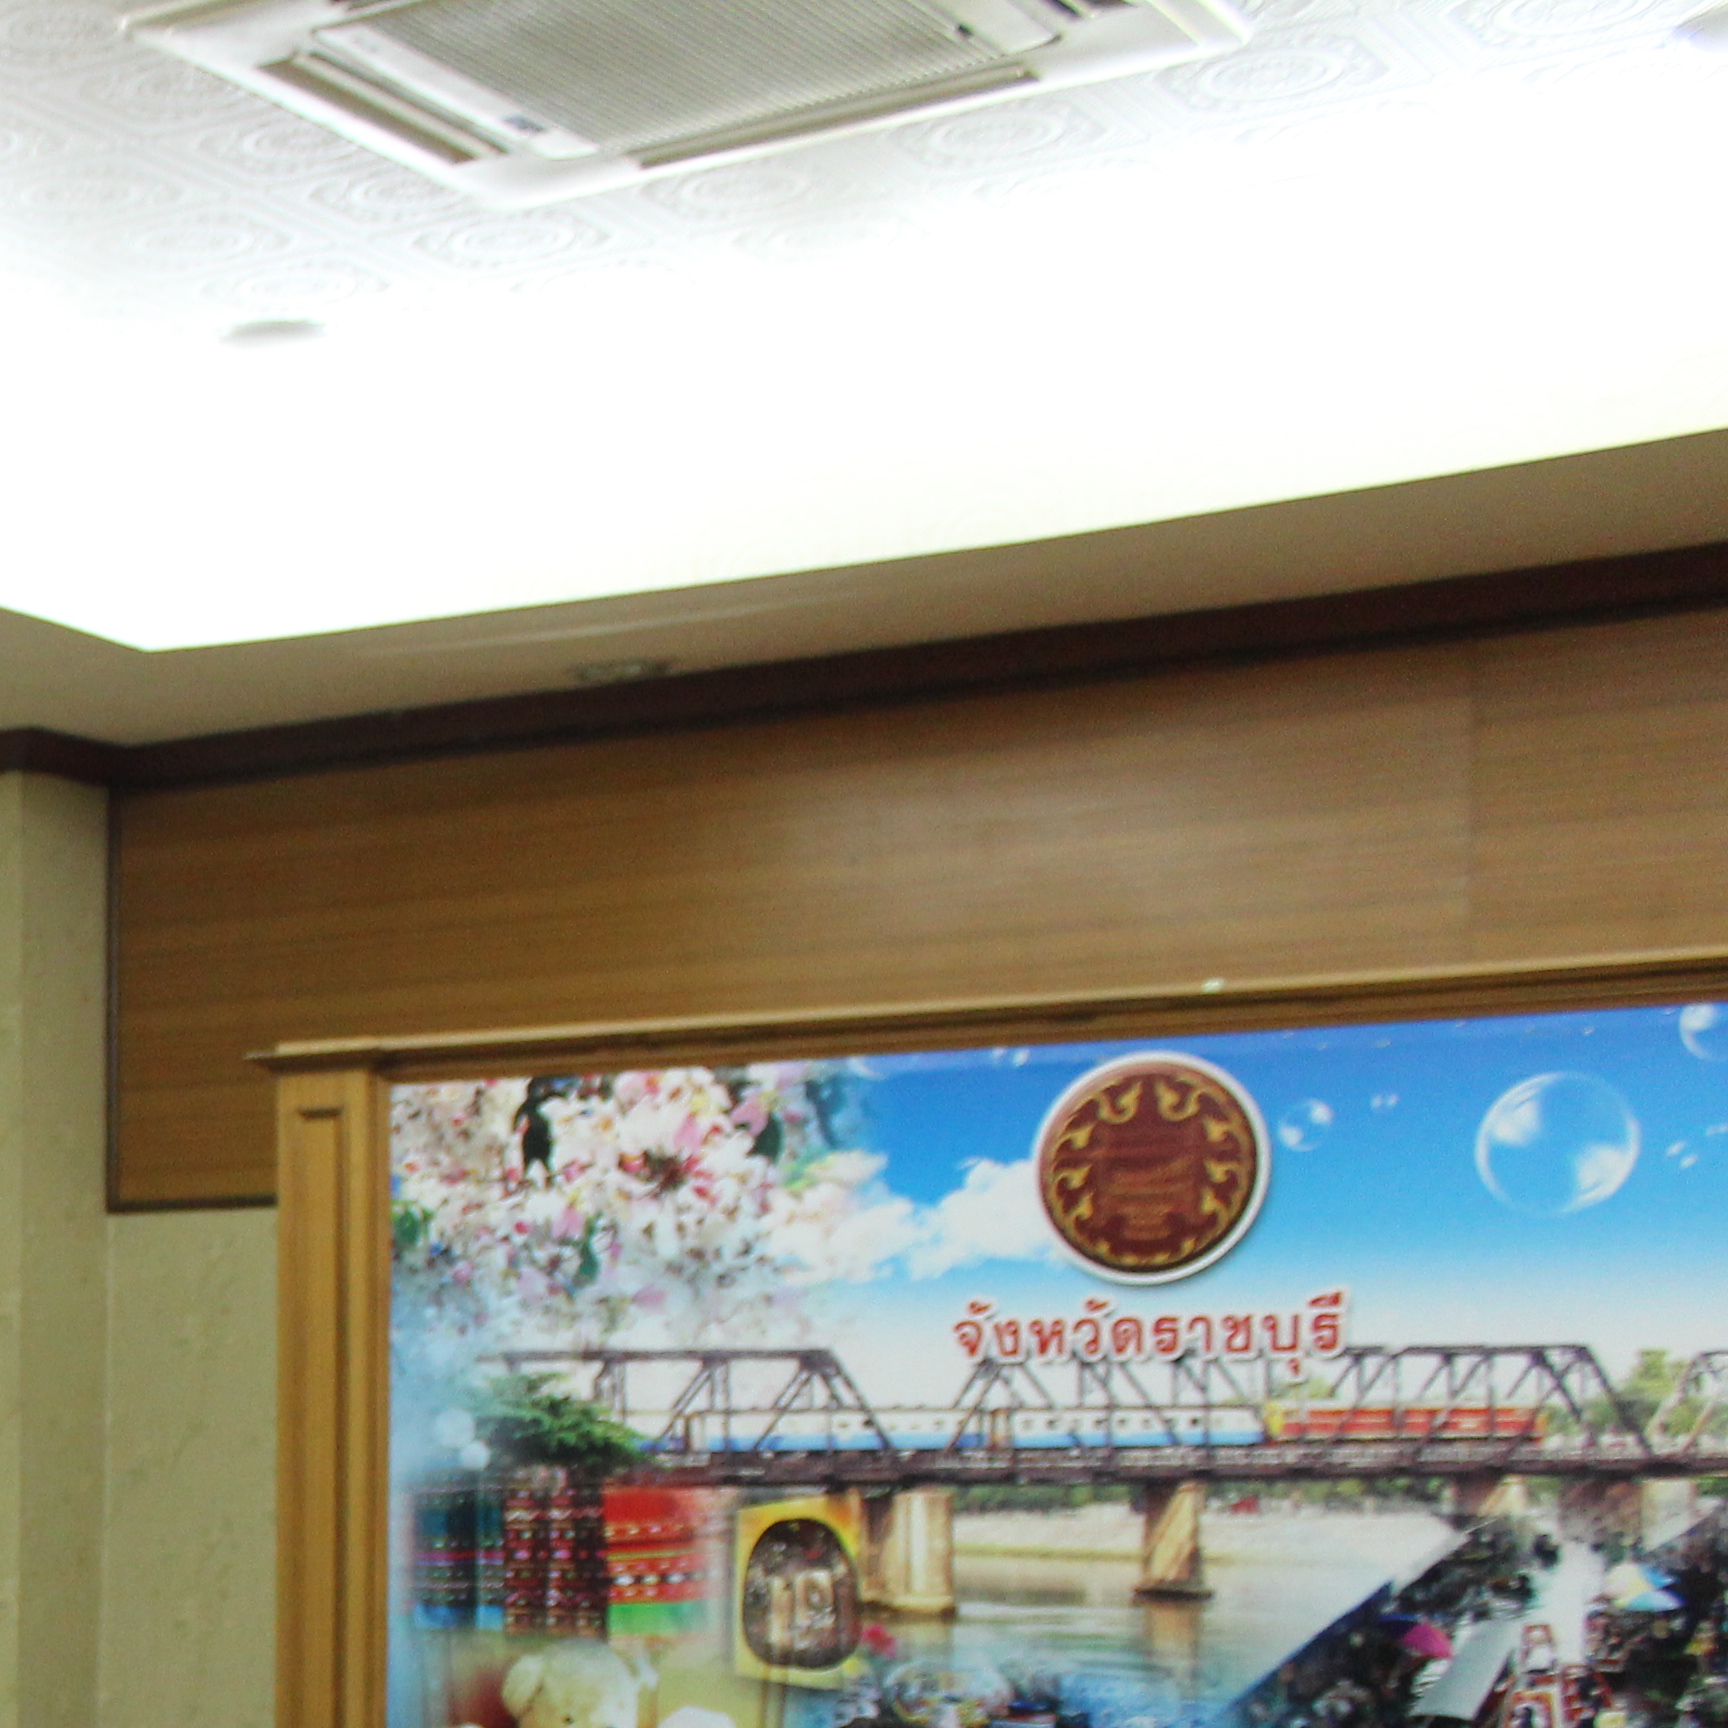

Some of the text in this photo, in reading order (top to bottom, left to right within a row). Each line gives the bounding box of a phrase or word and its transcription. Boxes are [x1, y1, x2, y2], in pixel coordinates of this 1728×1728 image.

[954, 1291, 1345, 1376] จังหวัดราชบุรี
